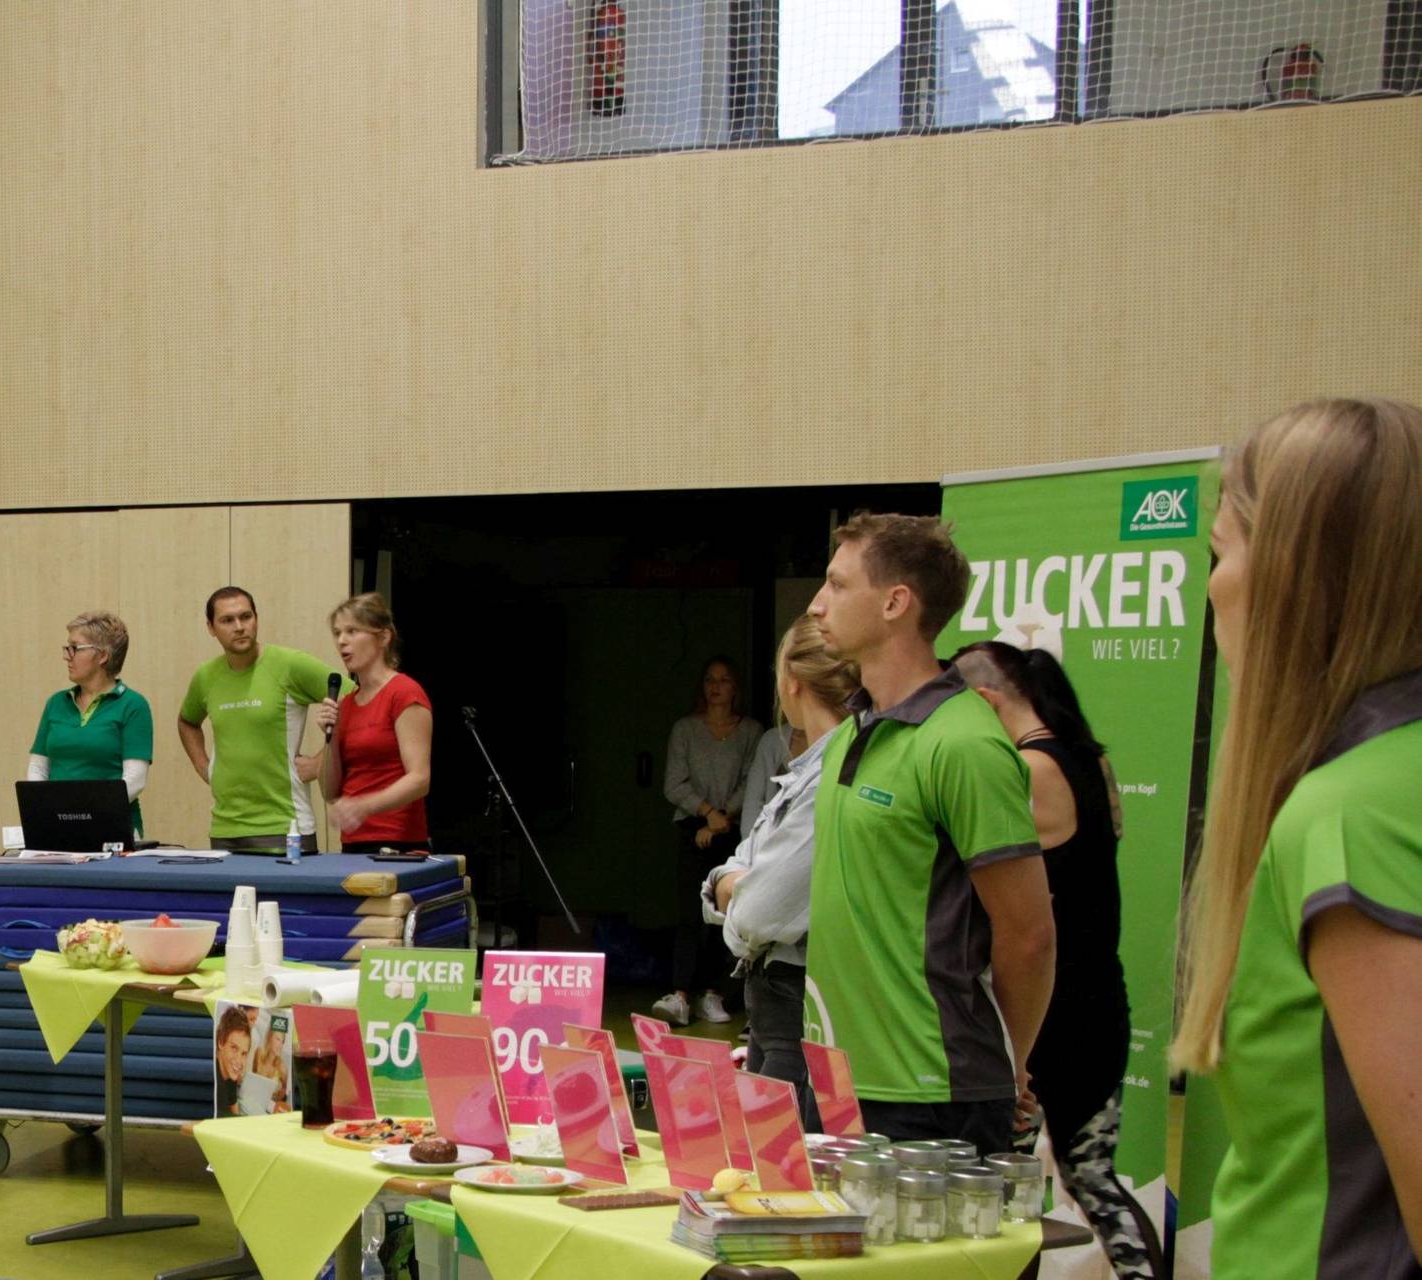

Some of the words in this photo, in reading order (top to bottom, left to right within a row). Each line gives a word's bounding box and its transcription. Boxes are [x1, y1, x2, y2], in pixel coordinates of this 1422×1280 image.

[1131, 488, 1188, 522] AOK
[960, 550, 1187, 632] ZUCKER
[1091, 638, 1123, 660] WIE
[57, 813, 92, 821] TOSHIBA
[368, 959, 466, 985] ZUCKER
[491, 963, 593, 989] ZUCKER
[365, 1021, 419, 1068] 50
[492, 1026, 549, 1075] 90
